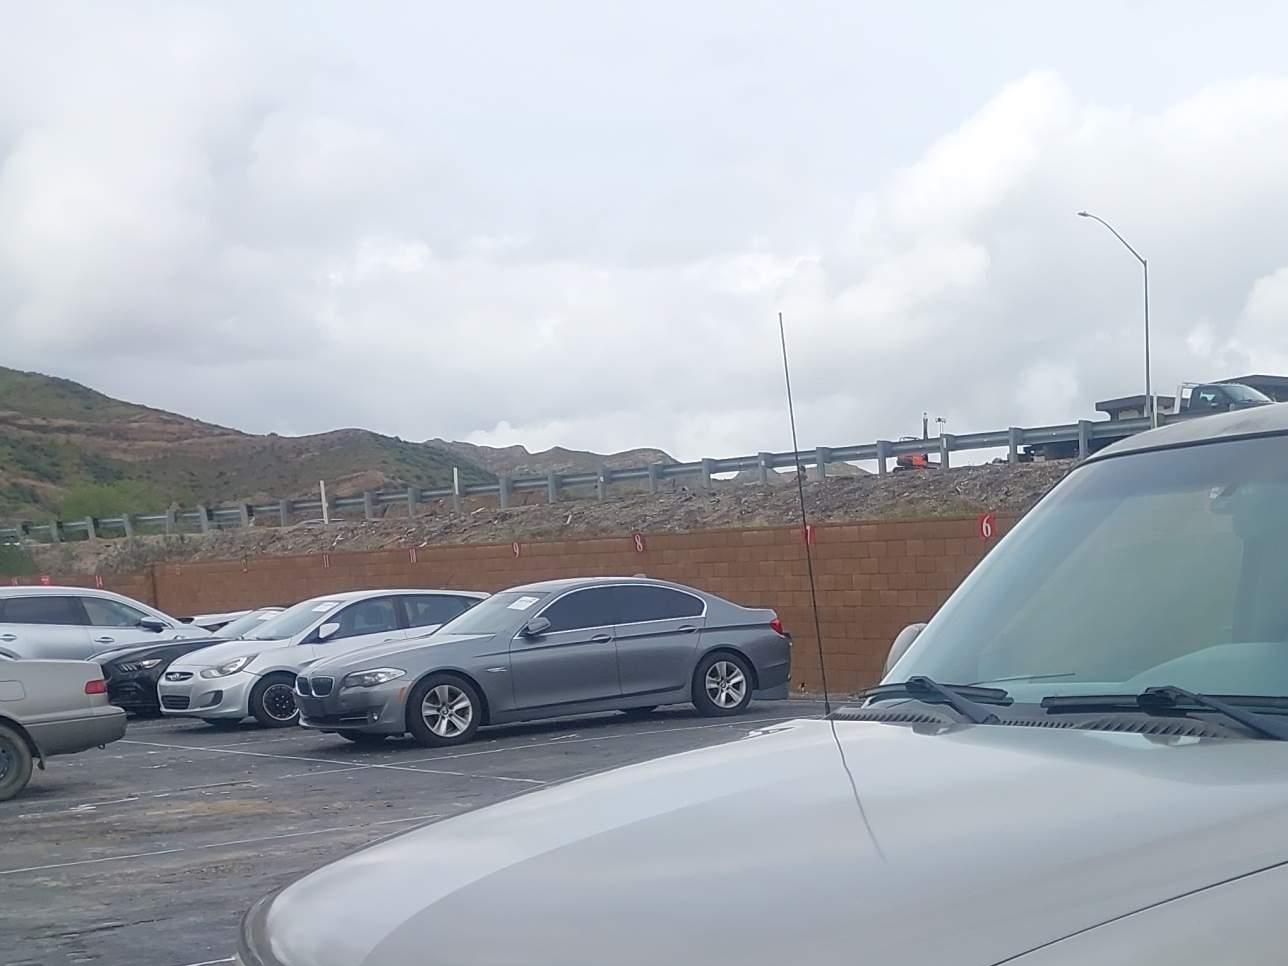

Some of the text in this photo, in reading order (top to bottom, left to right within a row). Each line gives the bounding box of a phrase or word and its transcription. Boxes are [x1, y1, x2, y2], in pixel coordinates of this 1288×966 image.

[982, 515, 991, 537] 6
[513, 542, 519, 558] 9
[634, 534, 643, 552] 8
